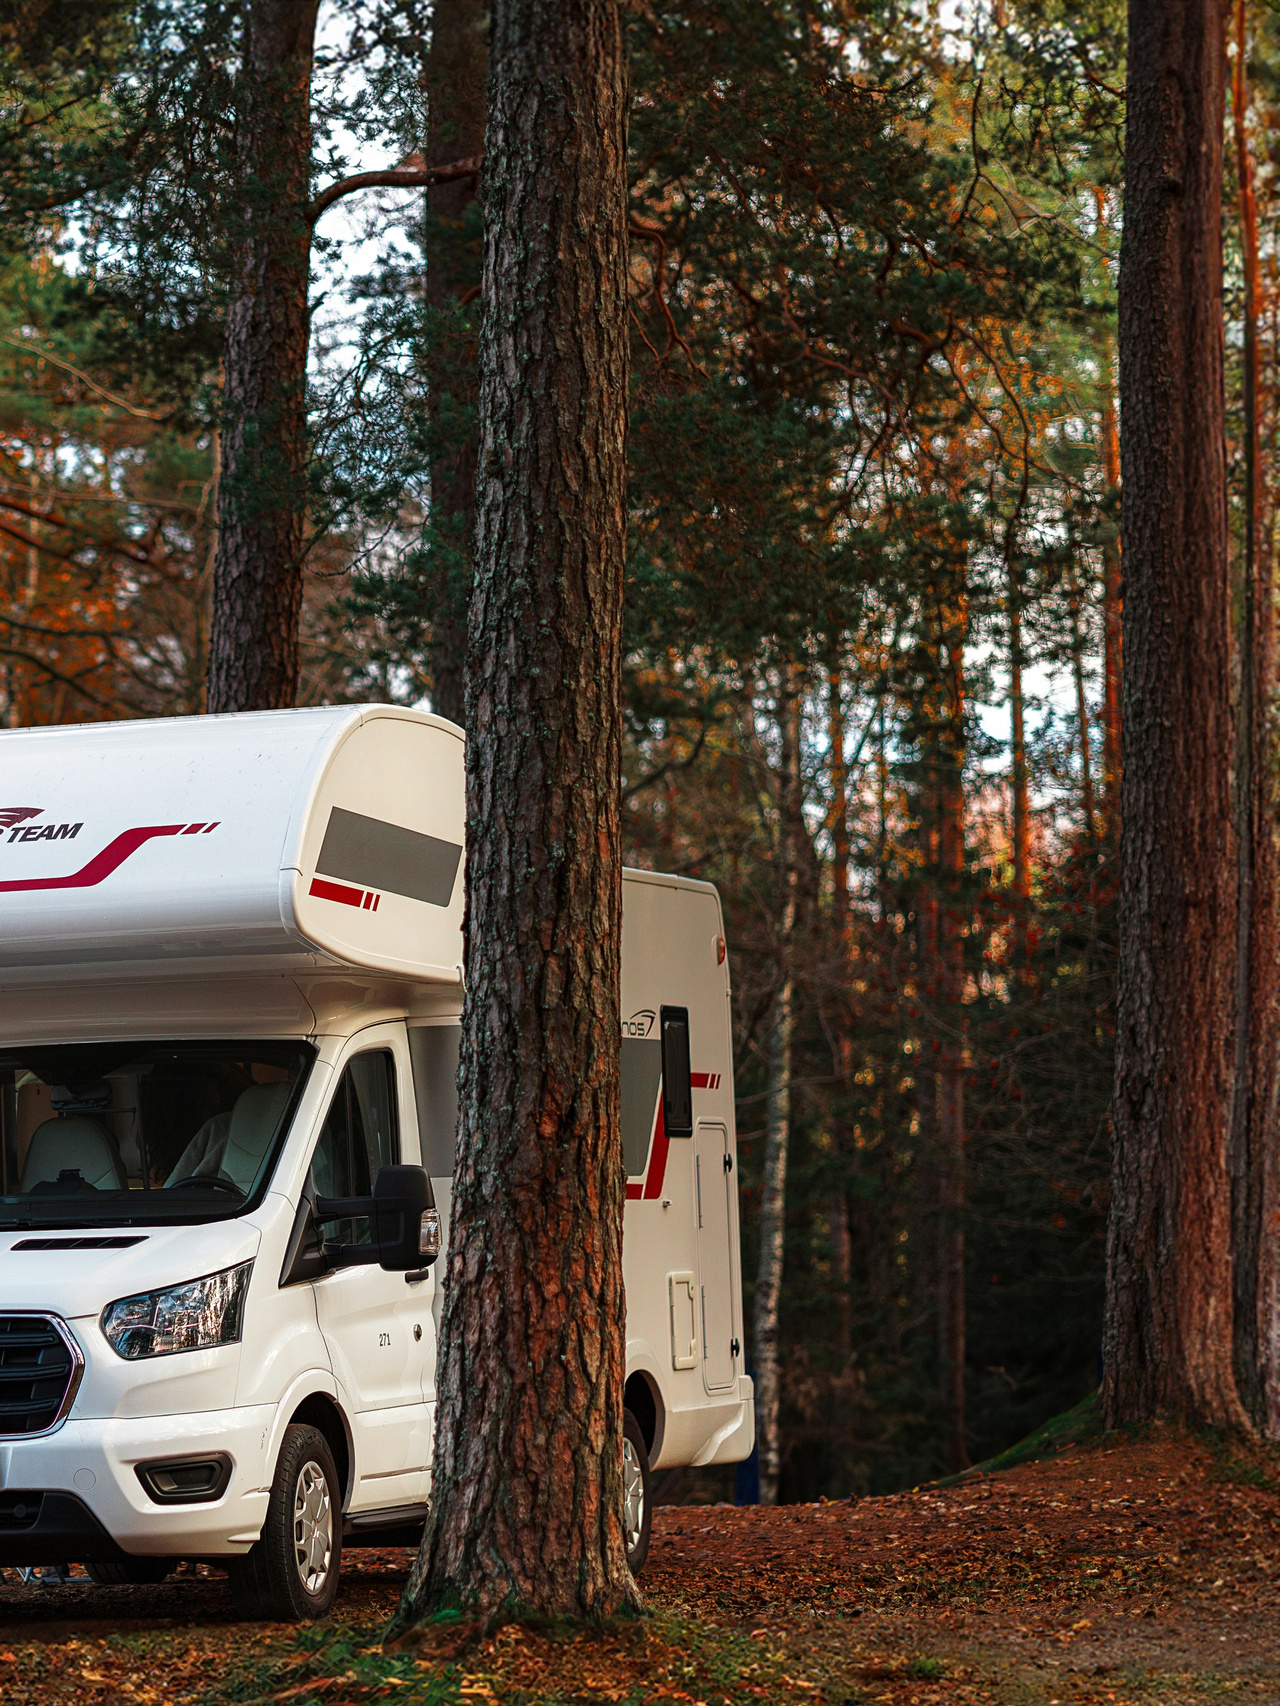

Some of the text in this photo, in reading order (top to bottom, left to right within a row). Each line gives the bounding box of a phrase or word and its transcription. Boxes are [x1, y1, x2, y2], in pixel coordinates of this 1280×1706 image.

[6, 822, 84, 844] TEAM
[621, 1021, 645, 1037] nos
[379, 1333, 391, 1347] 271
